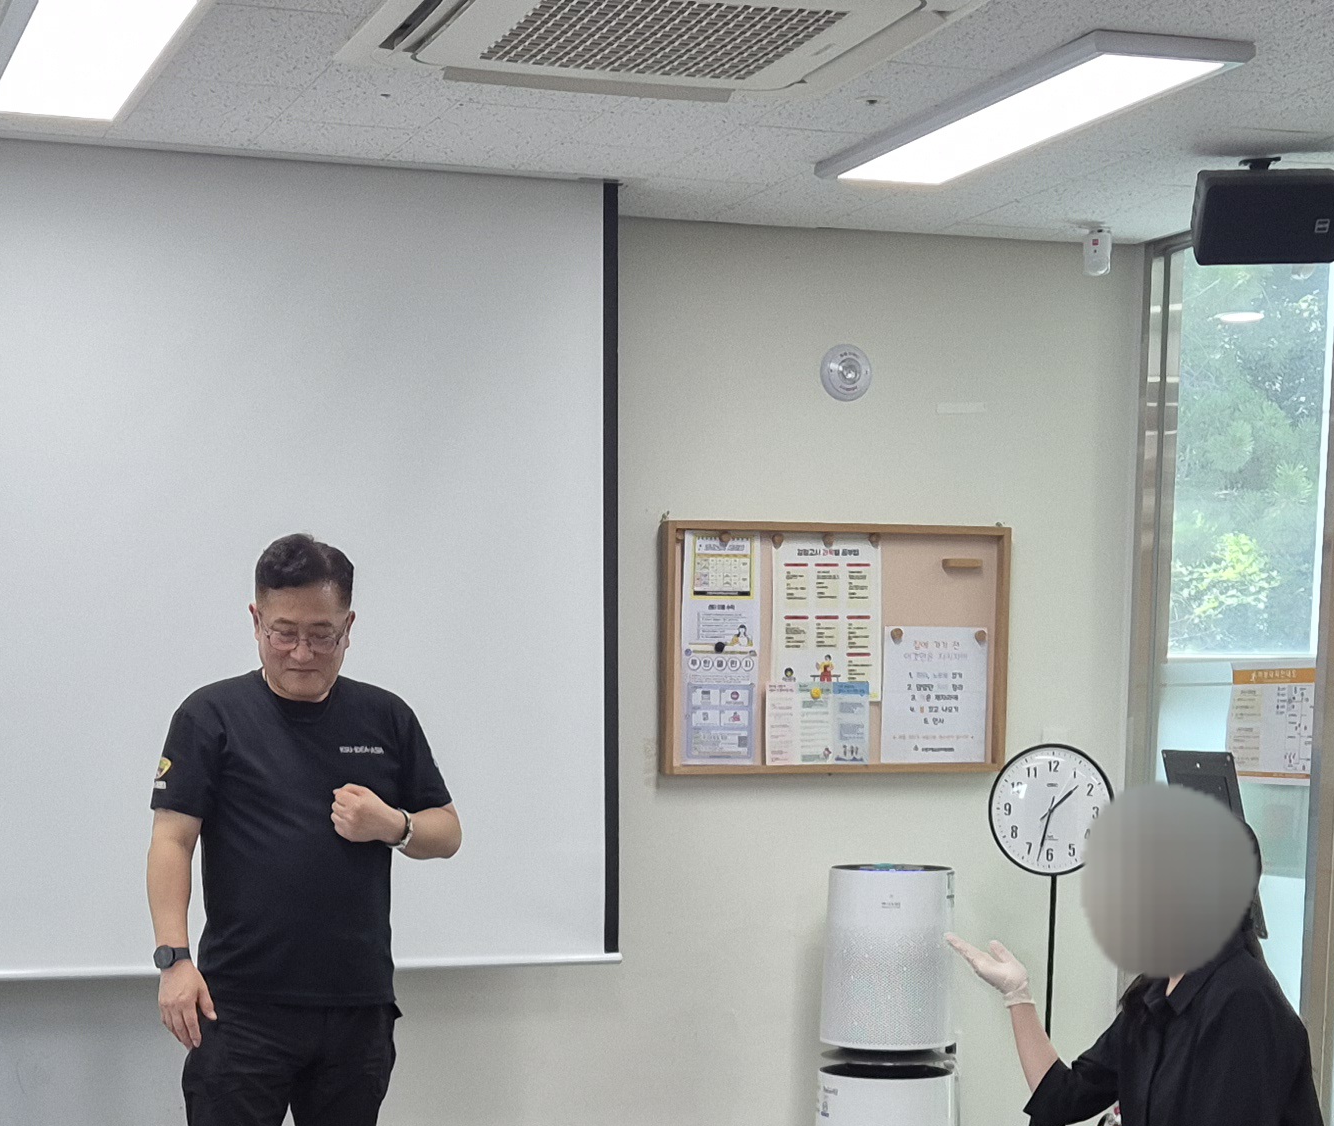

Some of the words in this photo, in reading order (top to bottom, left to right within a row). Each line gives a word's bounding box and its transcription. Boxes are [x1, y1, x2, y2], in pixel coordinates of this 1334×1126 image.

[1027, 767, 1038, 778] 11
[1048, 760, 1060, 773] 12
[1073, 768, 1077, 779] 1
[1086, 783, 1094, 797] 2
[1004, 803, 1012, 816] 9
[1092, 806, 1100, 820] 3
[1010, 825, 1018, 839] 8
[1026, 842, 1033, 855] 7
[1046, 848, 1053, 862] 6
[1068, 843, 1076, 857] 5
